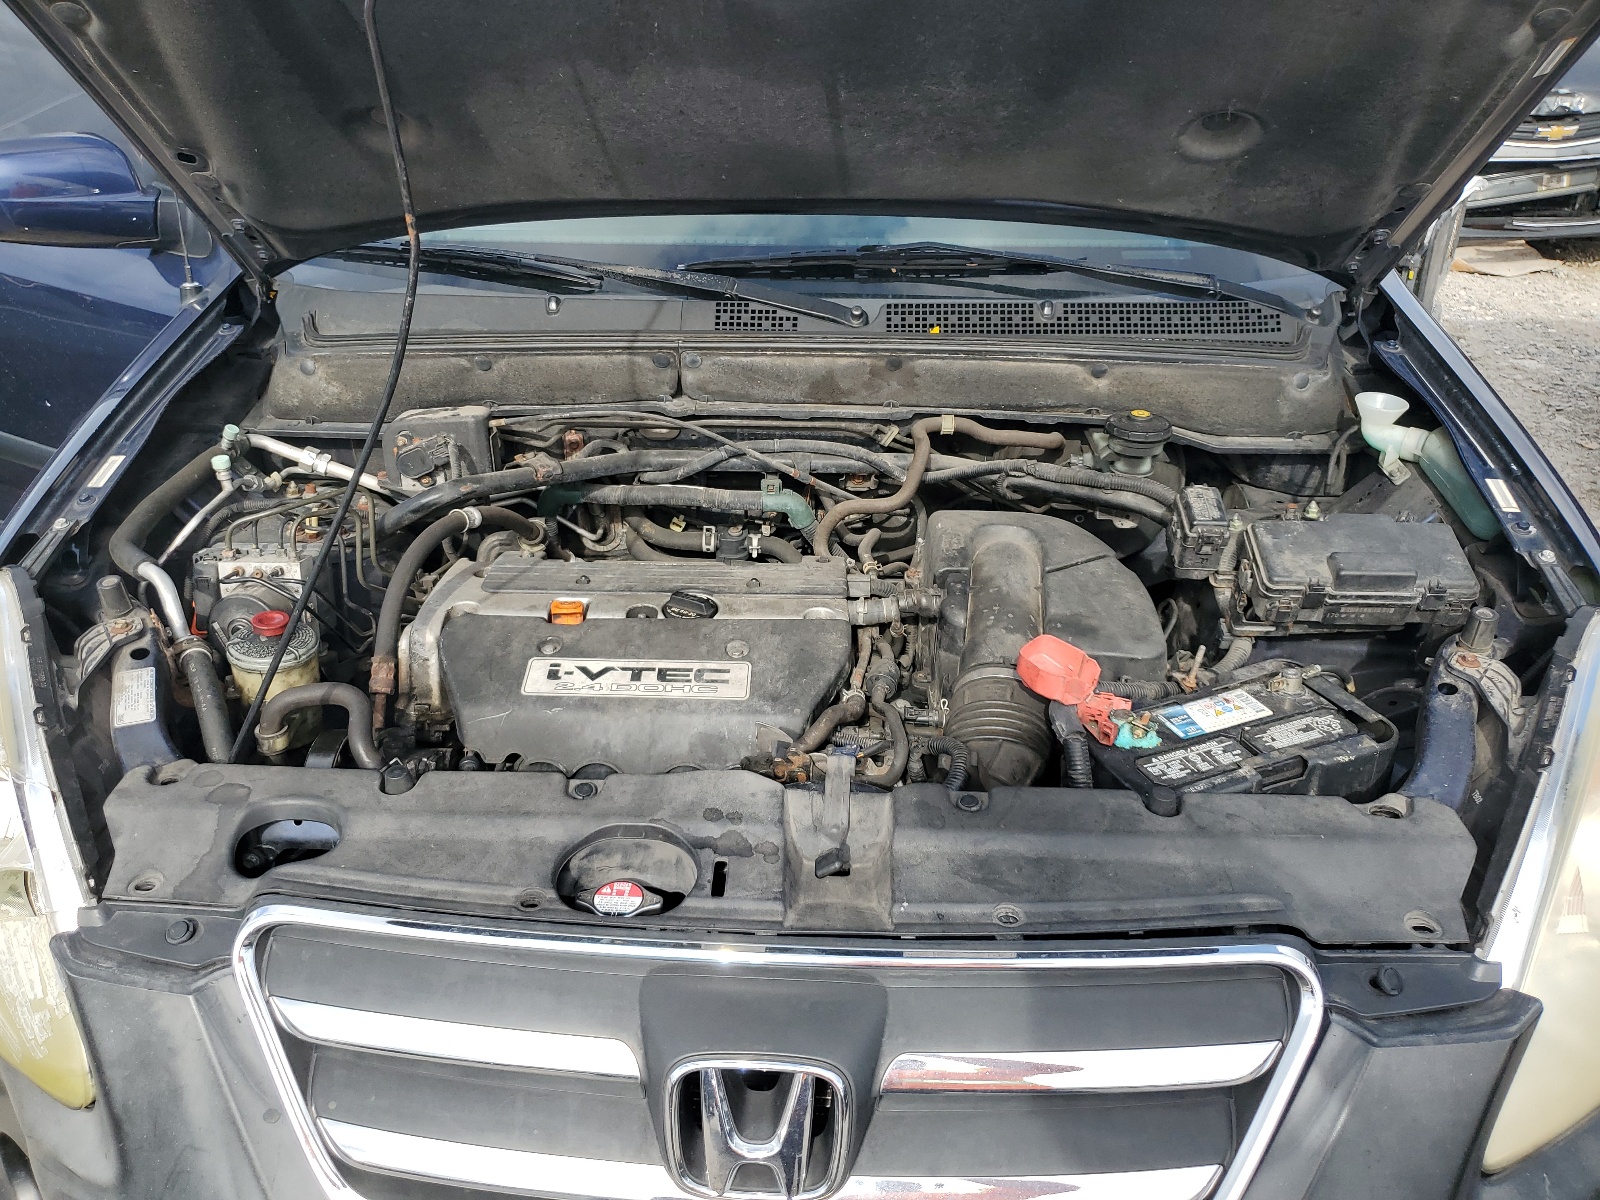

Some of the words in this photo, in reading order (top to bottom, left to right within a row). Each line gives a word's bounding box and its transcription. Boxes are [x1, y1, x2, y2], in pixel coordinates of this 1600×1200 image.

[547, 662, 731, 684] i-VTEC
[554, 682, 604, 692] 2.4
[610, 683, 719, 694] DOHC
